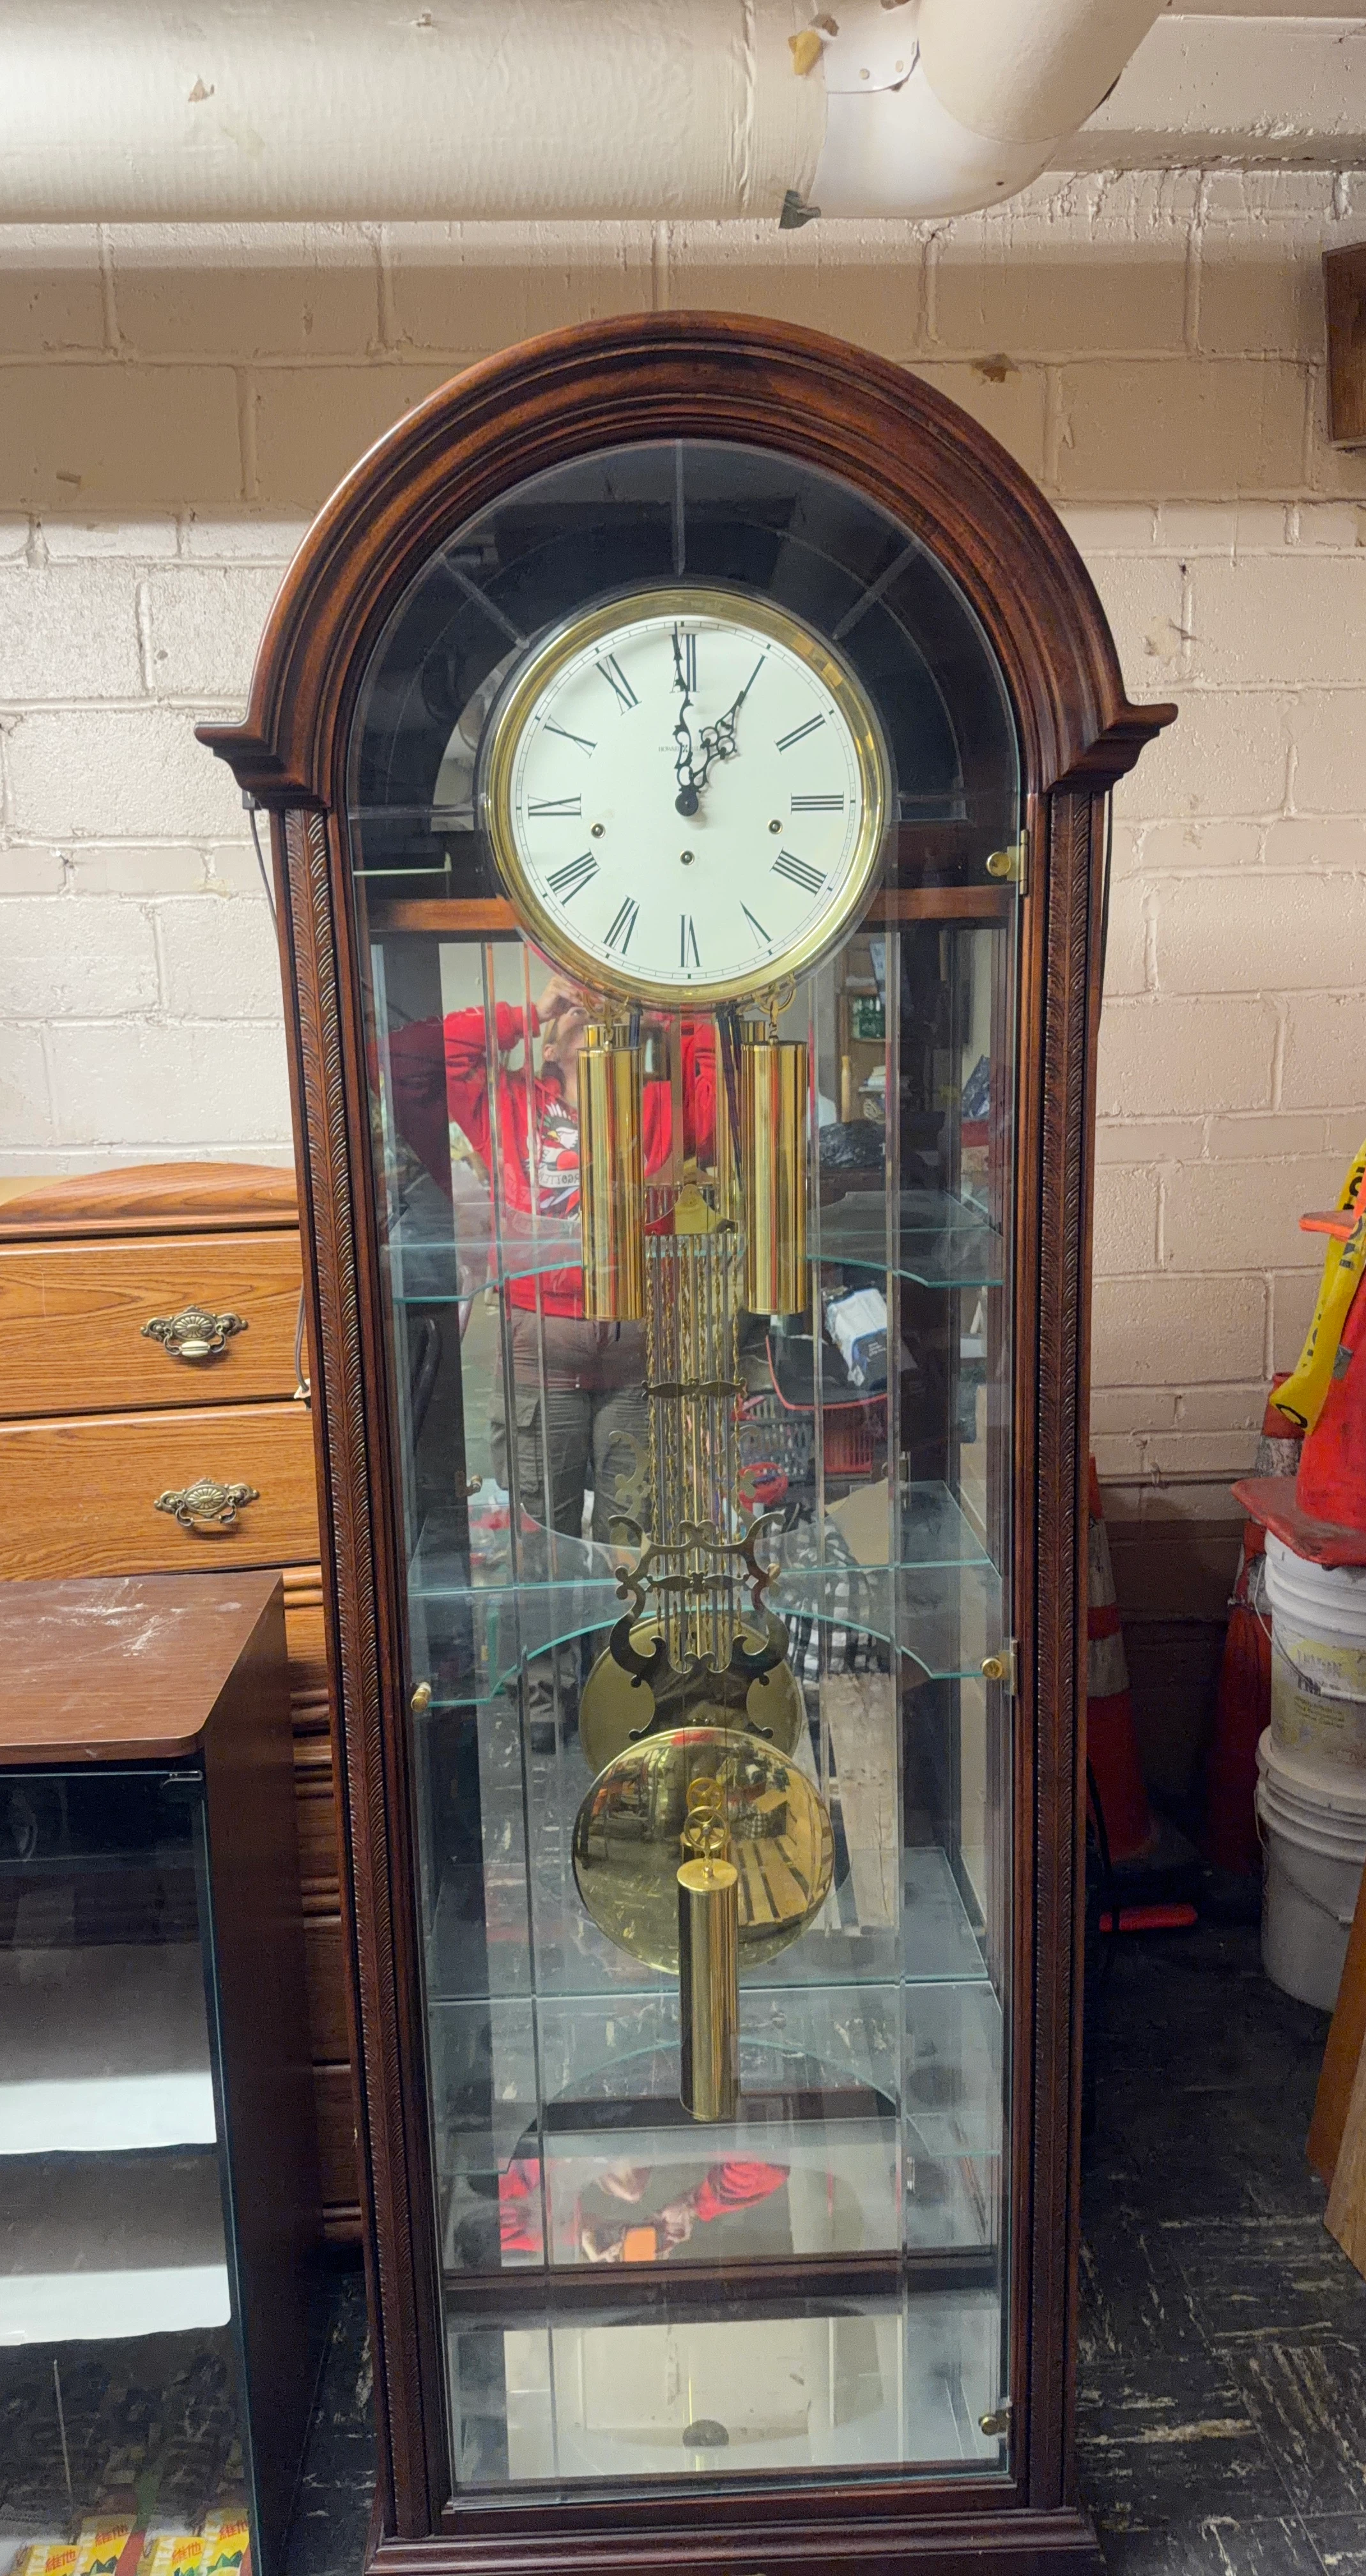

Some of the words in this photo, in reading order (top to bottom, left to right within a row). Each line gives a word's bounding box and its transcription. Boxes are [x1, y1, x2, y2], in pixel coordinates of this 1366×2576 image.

[594, 652, 642, 716] XI
[542, 716, 597, 758] X
[774, 710, 827, 754] II
[527, 793, 582, 818] IX
[790, 792, 845, 815] III
[545, 848, 601, 905] VIII
[770, 847, 829, 895] IIII
[601, 894, 640, 954] VII
[678, 914, 702, 967] VI
[740, 900, 773, 949] V
